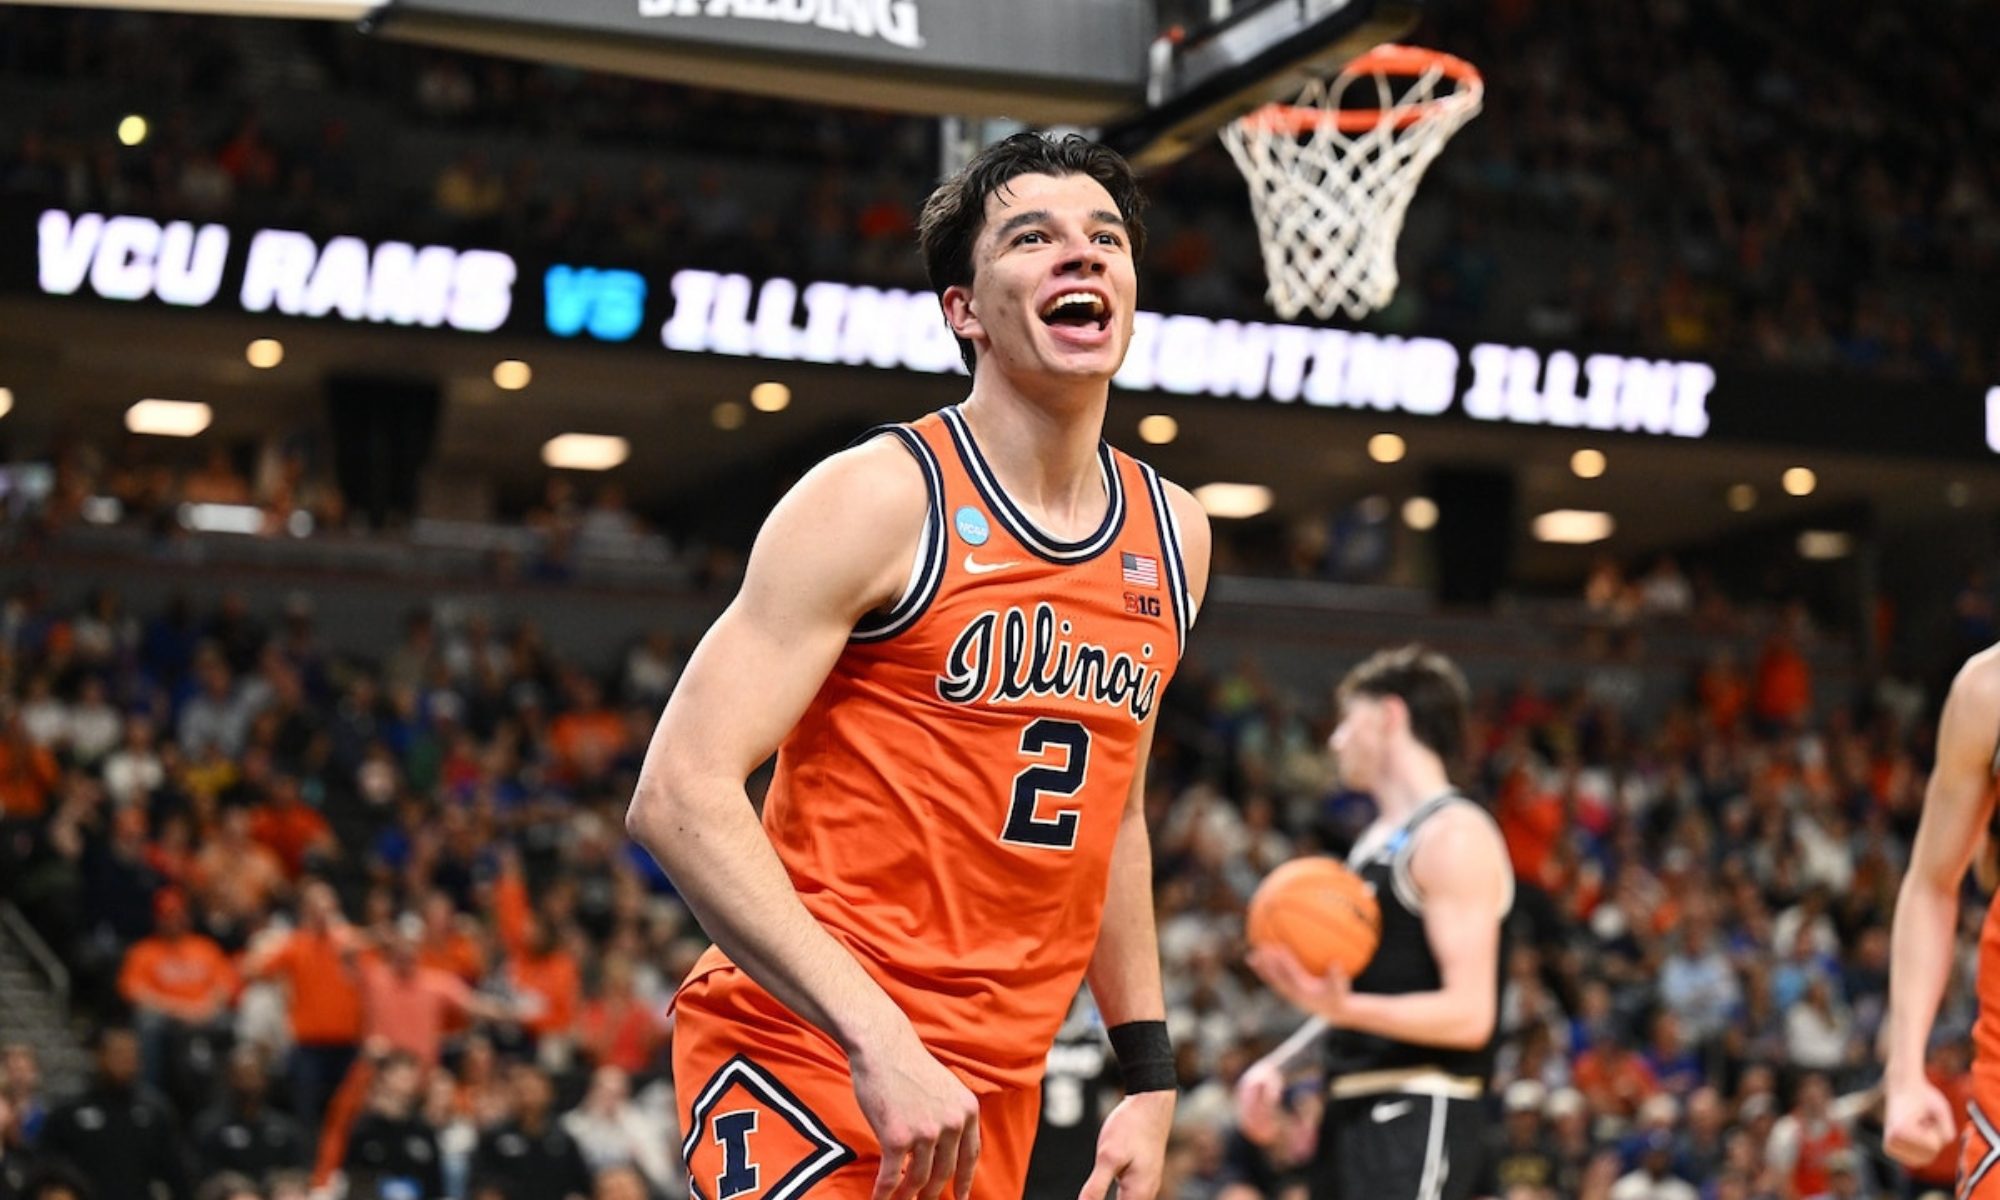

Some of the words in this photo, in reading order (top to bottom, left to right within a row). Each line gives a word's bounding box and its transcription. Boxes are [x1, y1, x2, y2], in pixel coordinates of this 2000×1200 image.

[38, 209, 229, 306] VCU
[241, 229, 517, 332] RAMS
[544, 264, 646, 341] VS
[661, 268, 971, 376] ILLINO
[1111, 311, 1460, 416] IGHTING
[1462, 343, 1716, 438] ILLINI
[936, 602, 1160, 724] Illinois
[1001, 717, 1090, 850] 2
[712, 1110, 760, 1200] I
